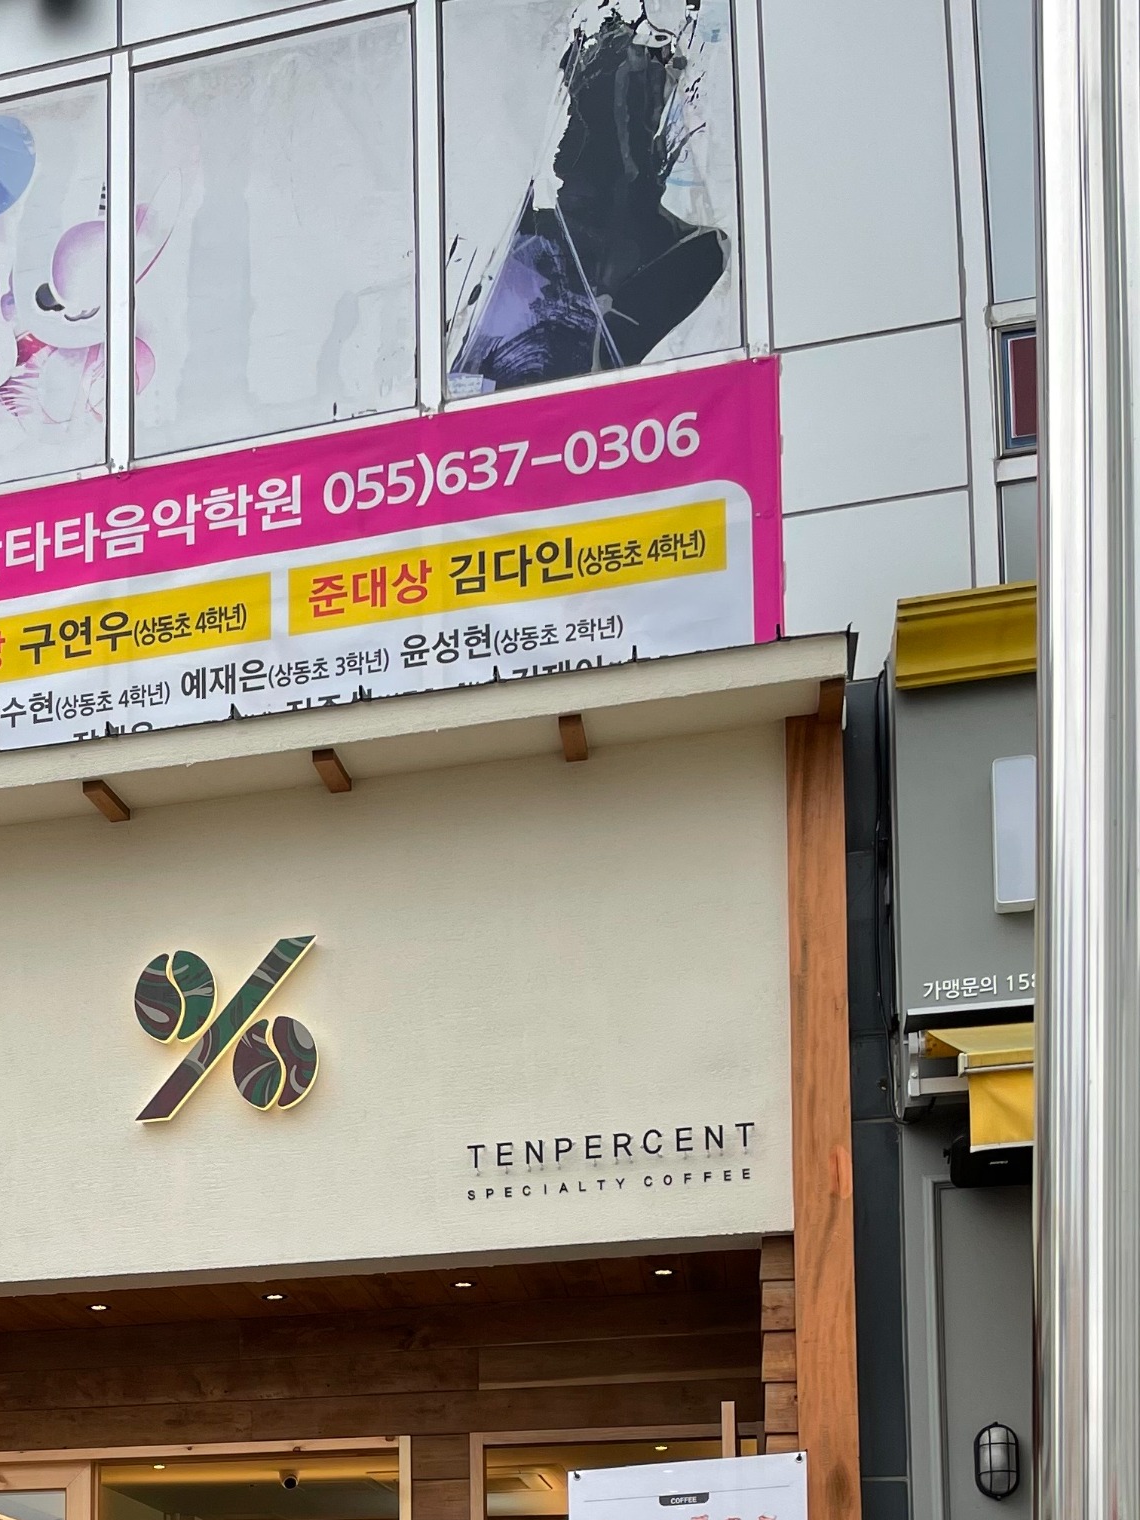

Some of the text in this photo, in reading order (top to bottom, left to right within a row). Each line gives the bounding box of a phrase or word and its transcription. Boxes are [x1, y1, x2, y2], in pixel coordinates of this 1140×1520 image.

[322, 411, 701, 515] 055)637-0306
[194, 602, 249, 636] 4학년)
[307, 557, 432, 619] 준대상
[646, 528, 707, 562] 4학년)
[117, 681, 172, 709] 4학년)
[334, 648, 391, 676] 3학년)
[564, 614, 625, 645] 2학년)
[922, 975, 998, 1000] 가맹문의
[466, 1121, 757, 1171] TENPERCENT
[466, 1167, 752, 1201] SPECIALTY COFFEE
[670, 1496, 698, 1505] COFFEE
